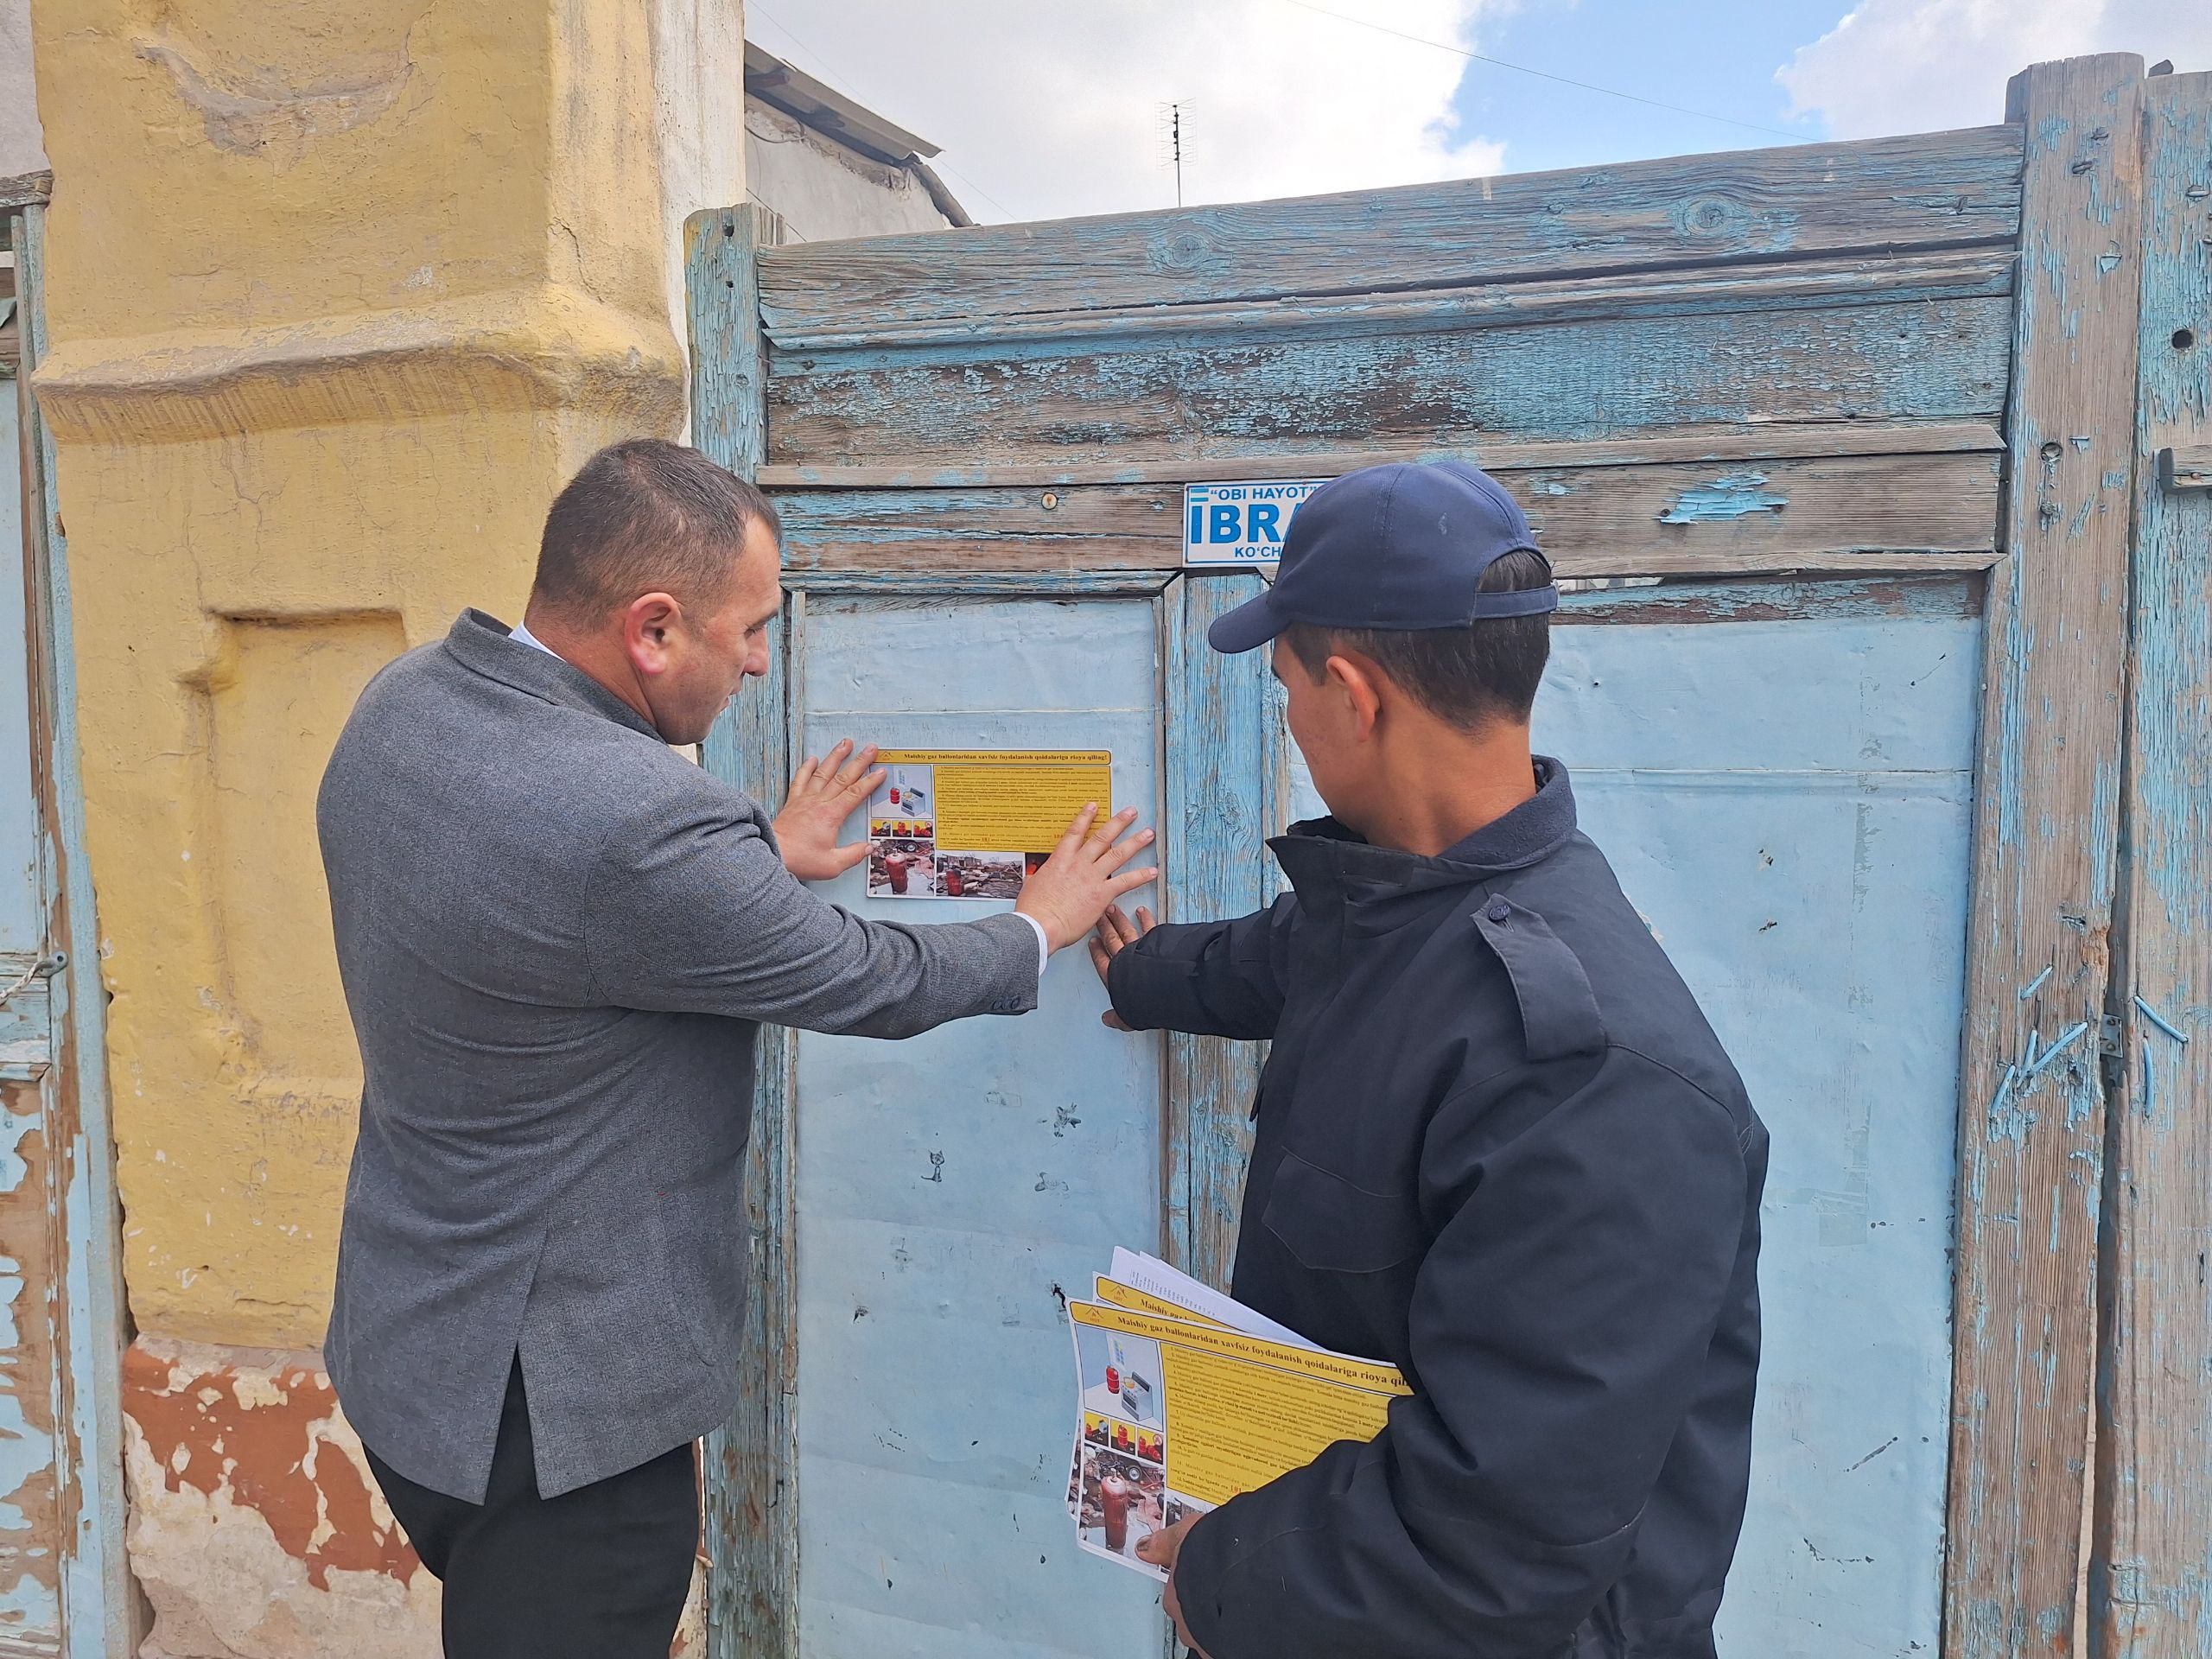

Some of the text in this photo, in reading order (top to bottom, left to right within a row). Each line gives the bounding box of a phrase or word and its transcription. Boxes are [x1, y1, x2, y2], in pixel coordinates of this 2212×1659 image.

[1235, 546, 1281, 558] KO‘CH
[1141, 1299, 1168, 1315] Maishiy
[1117, 1316, 1147, 1331] Maishiy
[1166, 1326, 1218, 1344] ballonlaridan
[1221, 1339, 1249, 1352] xavfsiz
[1252, 1345, 1302, 1364] foydalanish
[1304, 1359, 1357, 1377] qoidalariga
[1360, 1371, 1388, 1383] rioya
